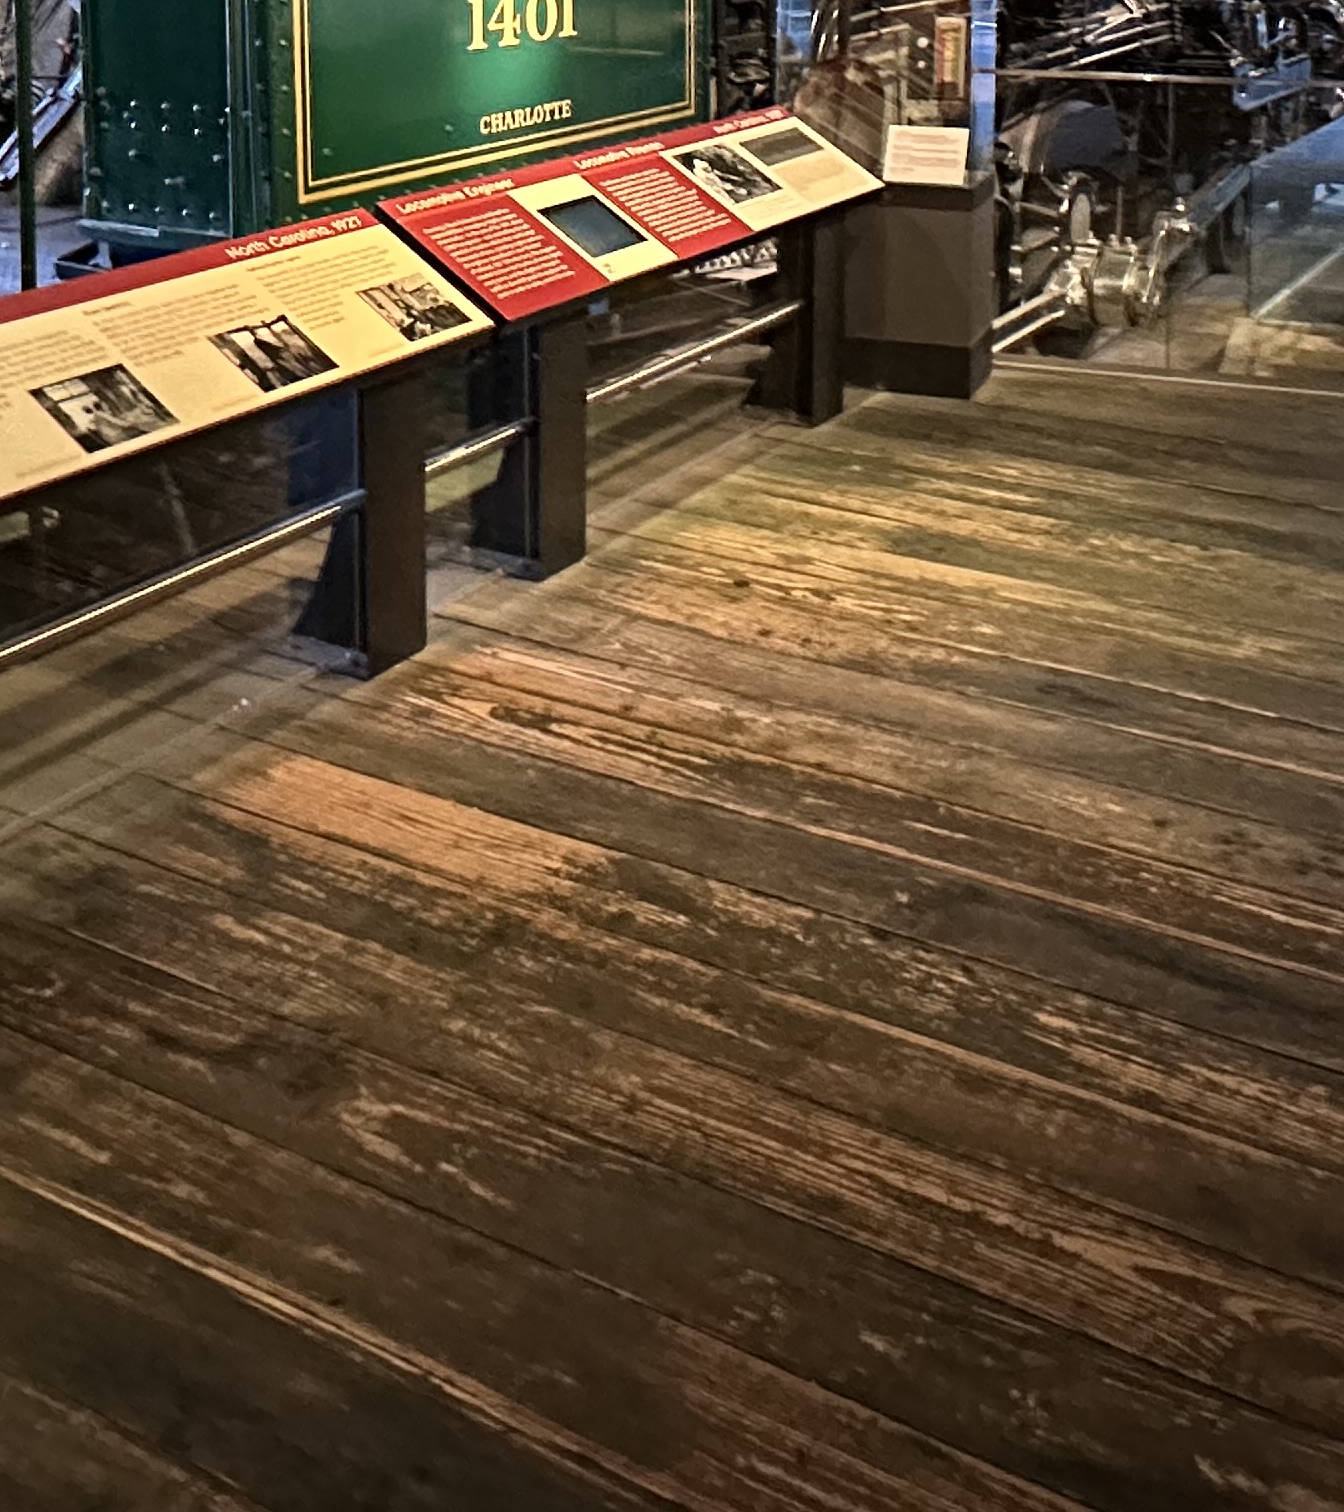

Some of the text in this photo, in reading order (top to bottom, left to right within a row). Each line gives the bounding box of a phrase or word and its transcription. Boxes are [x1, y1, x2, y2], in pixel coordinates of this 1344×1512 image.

[479, 99, 573, 135] CHARLOTTE
[396, 191, 466, 215] Locomotive
[225, 240, 270, 260] North
[268, 224, 337, 248] Carolina,
